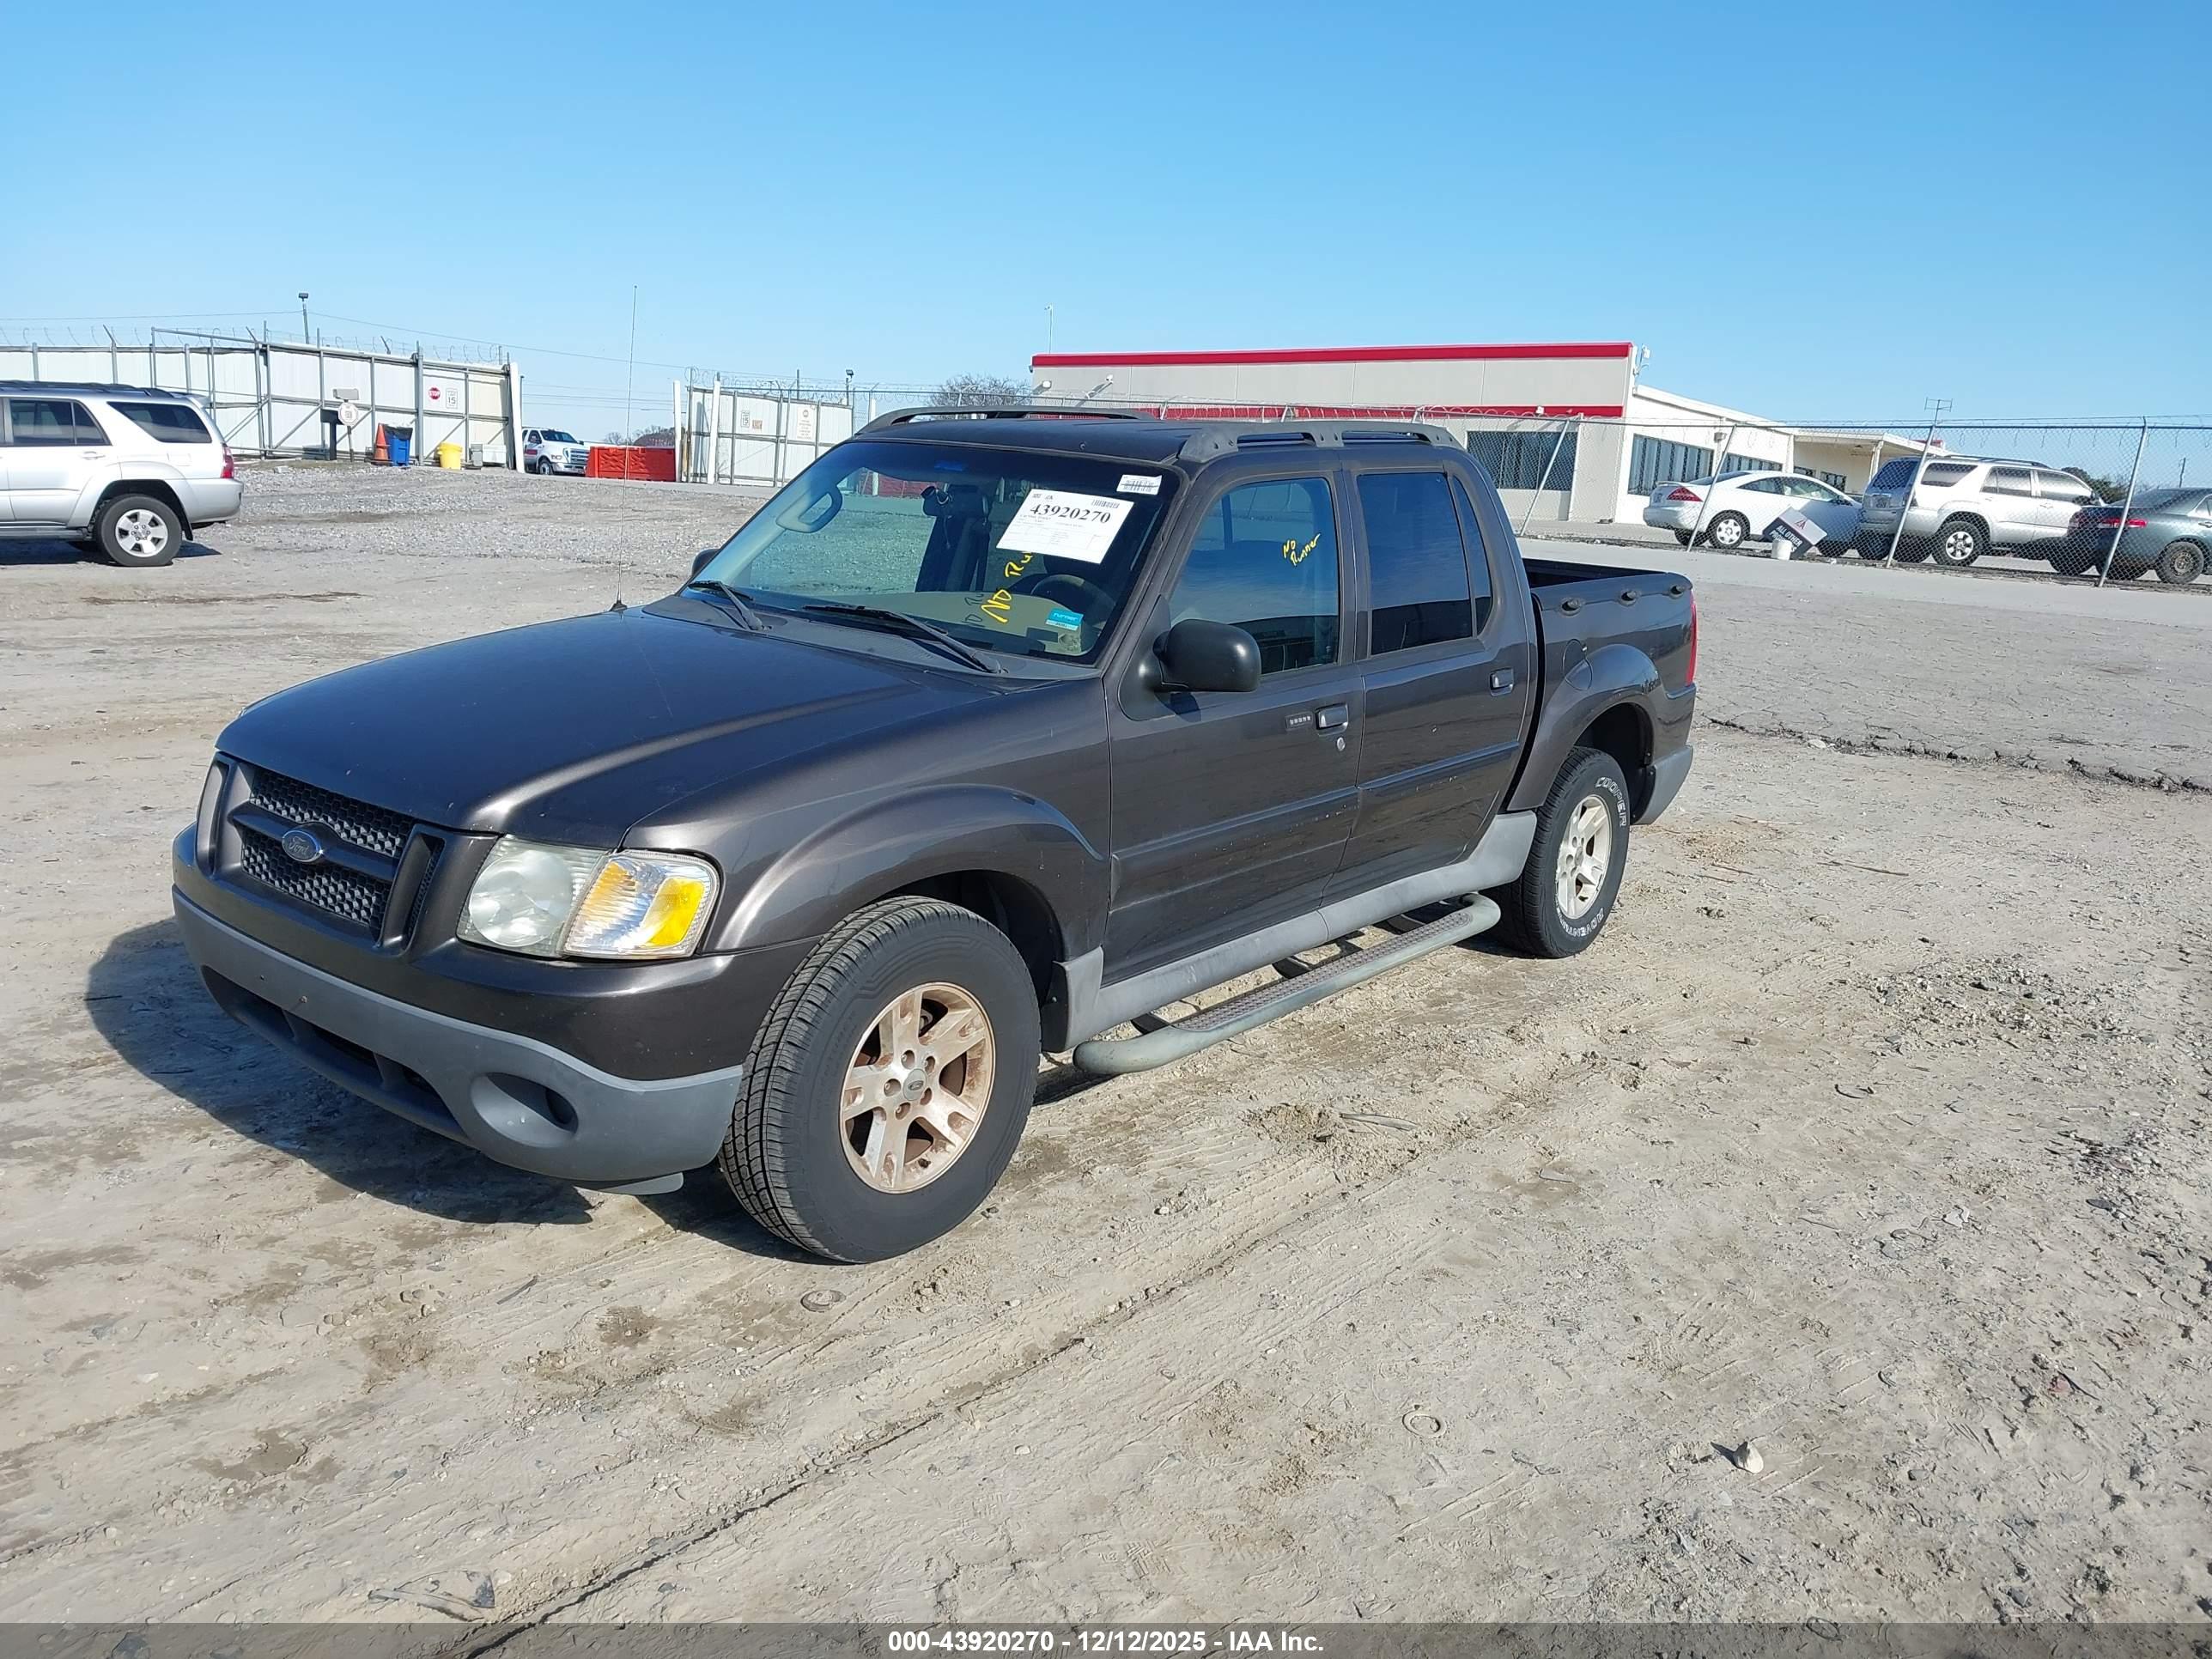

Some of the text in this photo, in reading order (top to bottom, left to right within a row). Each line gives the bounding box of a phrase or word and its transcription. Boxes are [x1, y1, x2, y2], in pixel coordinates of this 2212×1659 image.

[1030, 503, 1111, 524] 43920270
[1776, 525, 1803, 547] ALL OTHER
[1595, 776, 1627, 827] COOPER
